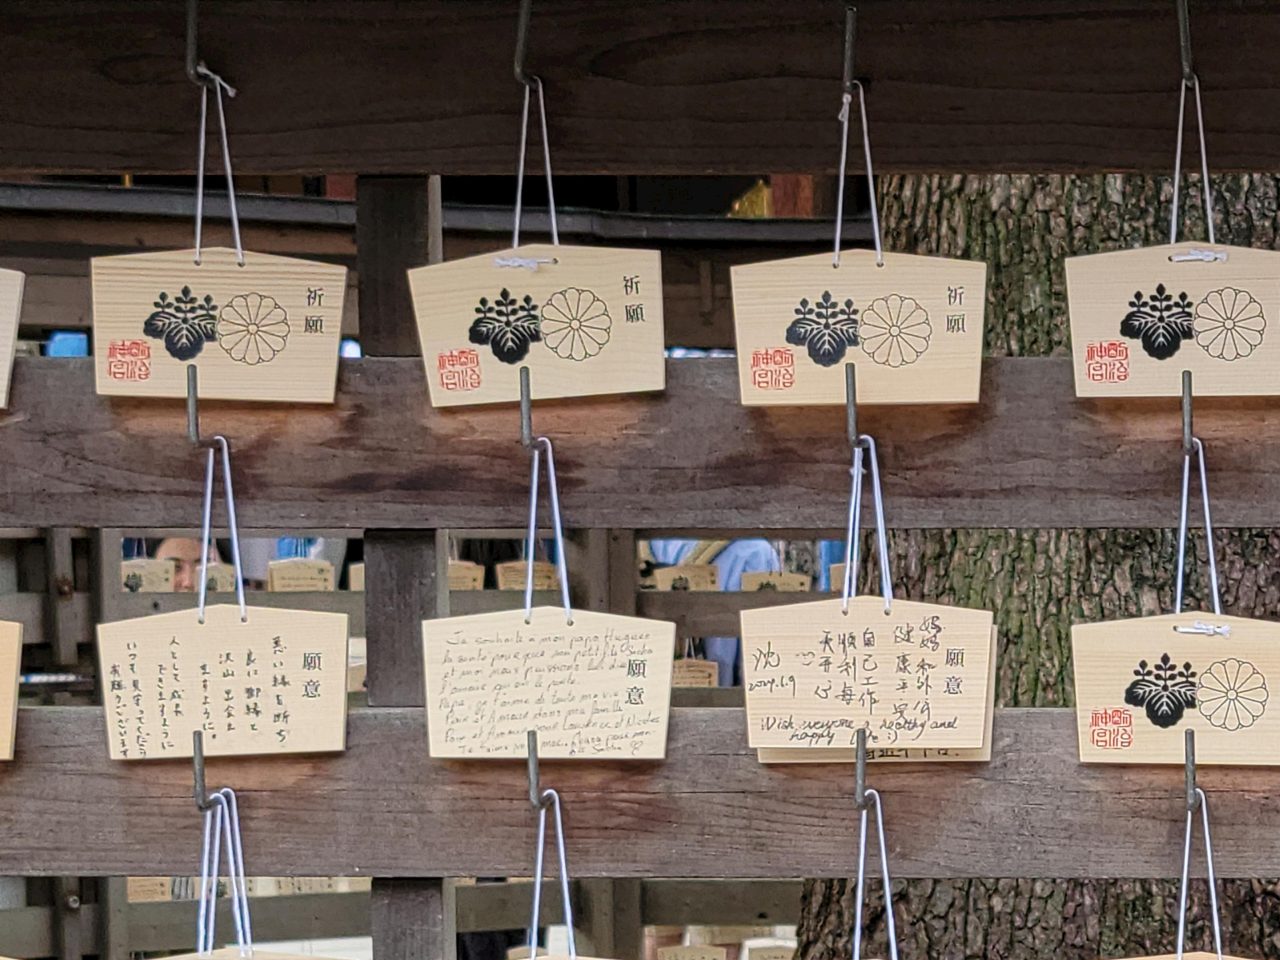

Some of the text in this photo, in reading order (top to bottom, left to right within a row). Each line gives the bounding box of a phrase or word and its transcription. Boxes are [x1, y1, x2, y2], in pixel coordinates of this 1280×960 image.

[303, 287, 325, 334] 祈願
[623, 275, 645, 323] 祈願
[946, 286, 966, 333] 祈願
[302, 652, 322, 699] 願意
[624, 659, 647, 705] 願意
[943, 648, 965, 695] 願意
[789, 731, 836, 745] happy
[930, 716, 958, 728] and
